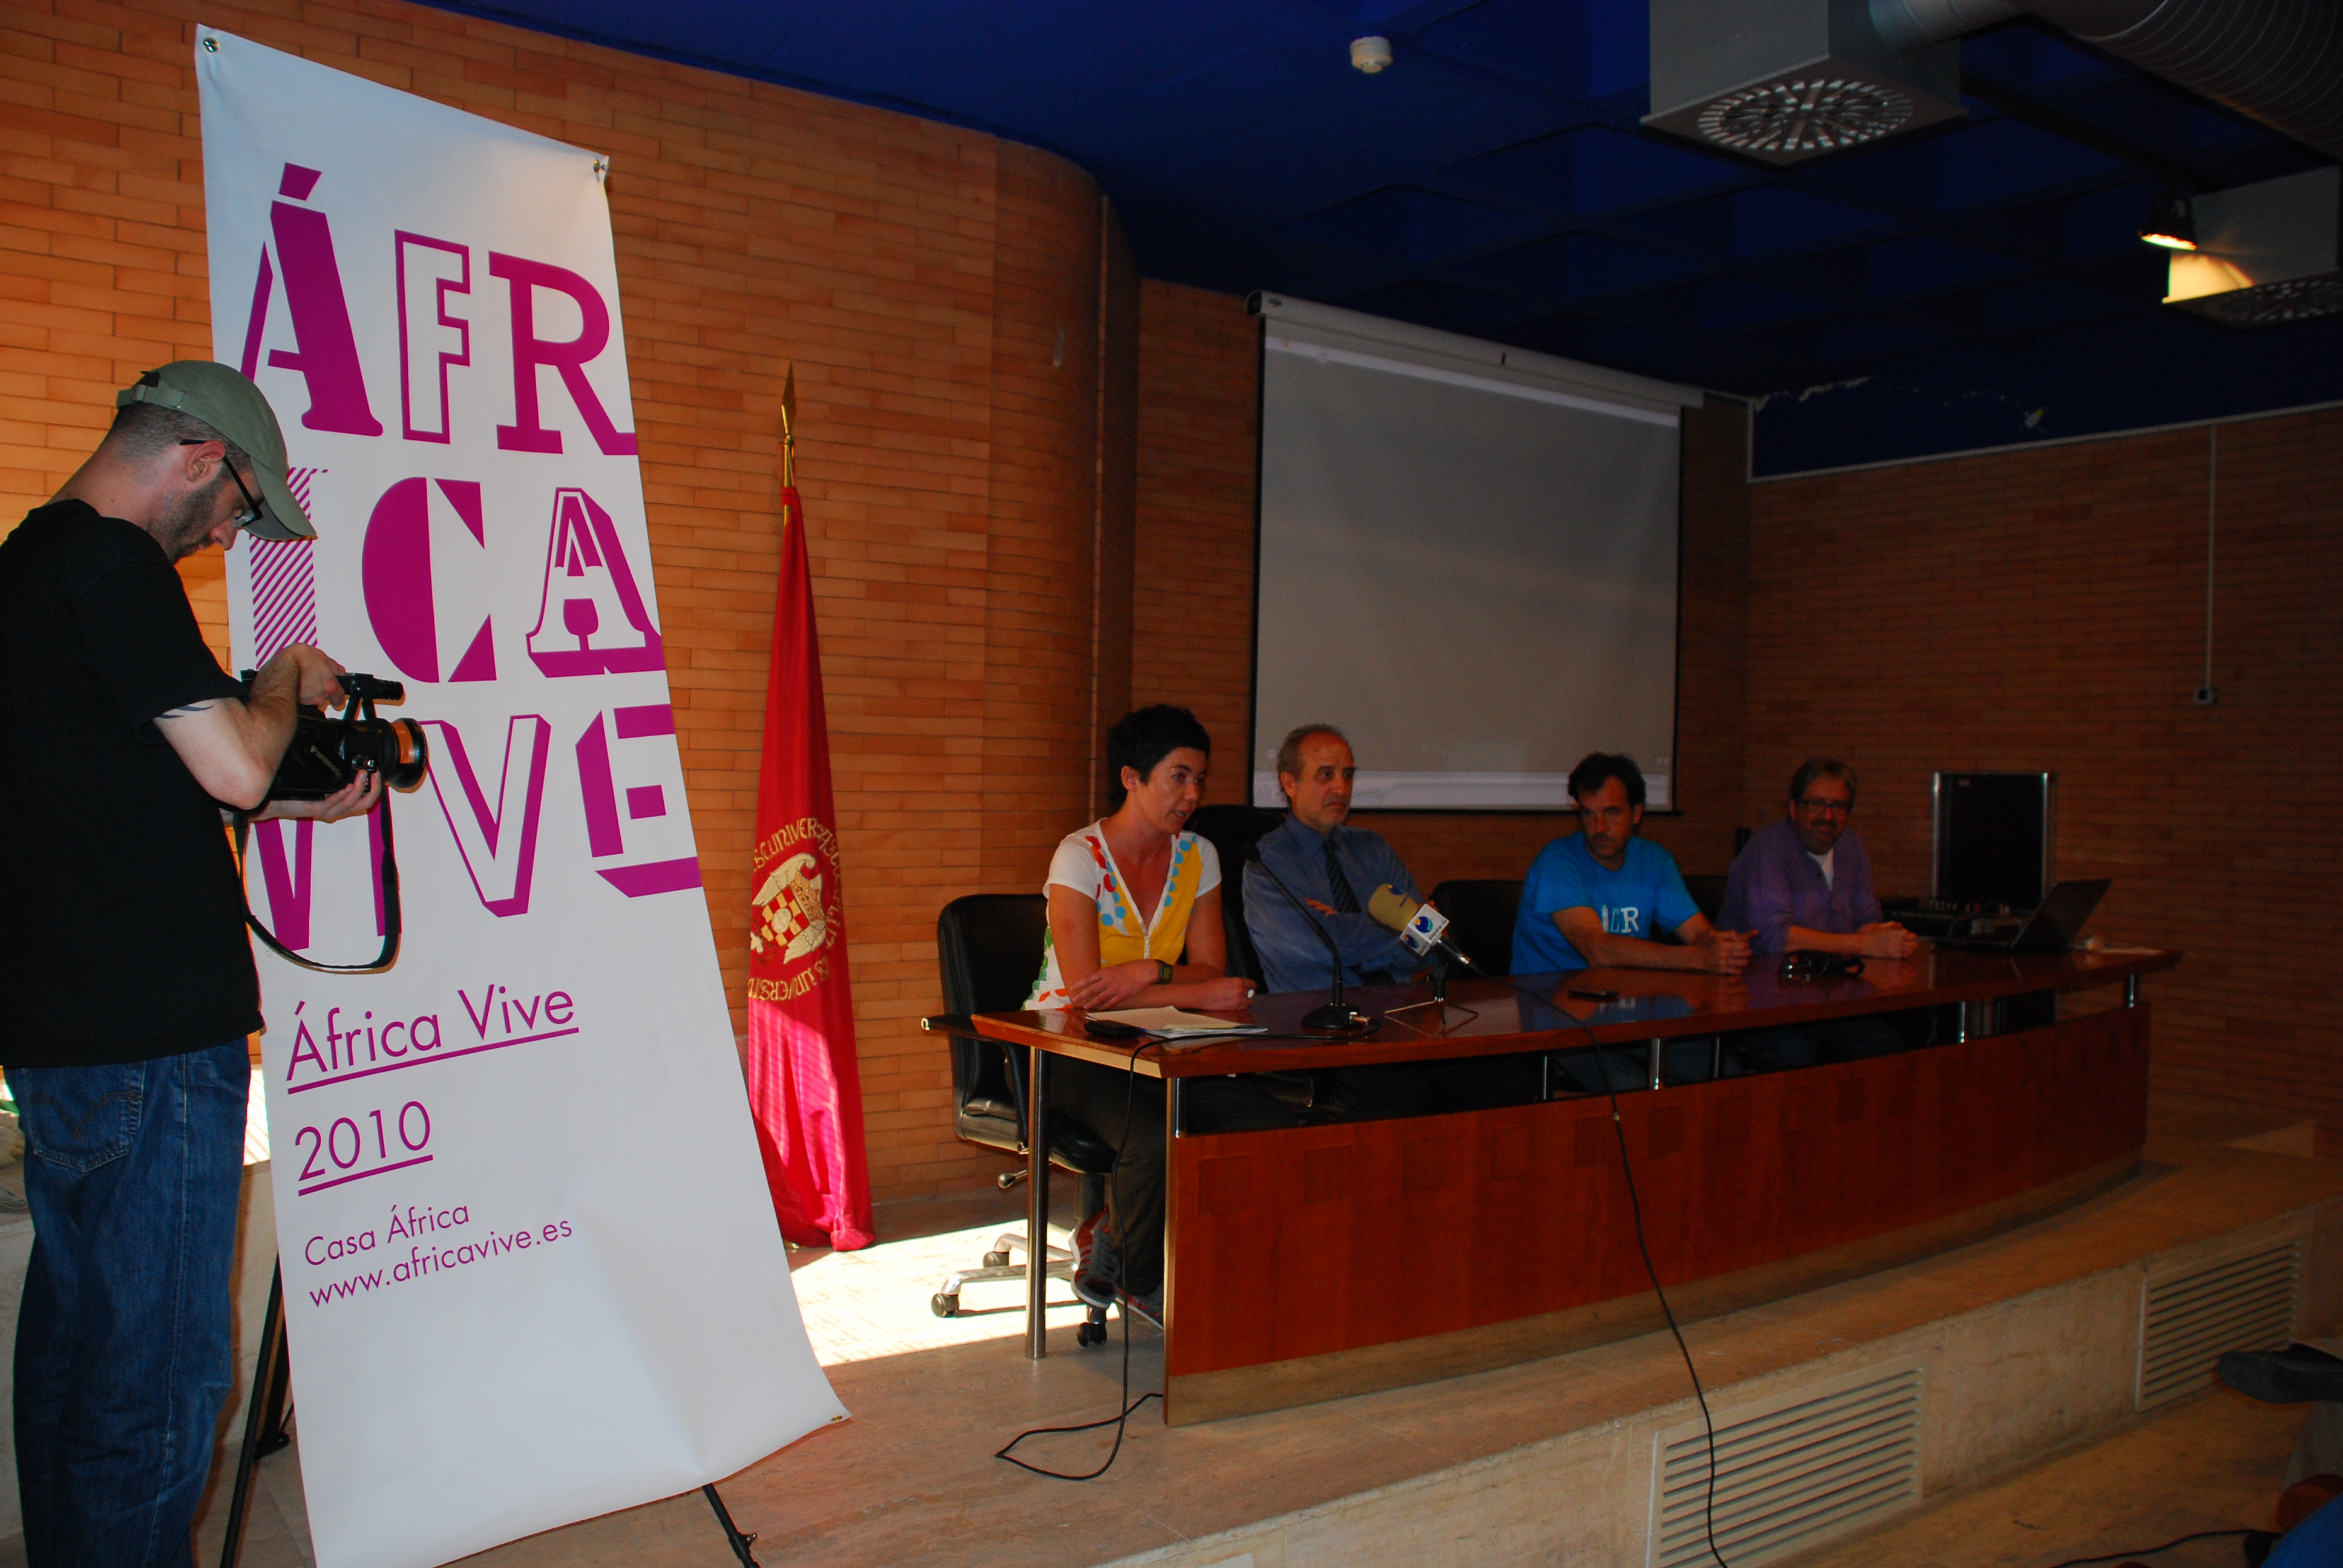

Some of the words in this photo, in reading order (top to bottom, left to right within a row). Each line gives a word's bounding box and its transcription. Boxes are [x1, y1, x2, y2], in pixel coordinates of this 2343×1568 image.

[241, 162, 638, 456] ÁFR
[253, 703, 703, 953] VVE
[286, 1001, 442, 1082] África
[457, 984, 574, 1040] Vive
[295, 1100, 431, 1181] 2010
[305, 1230, 376, 1266] Casa
[387, 1204, 470, 1243] África
[309, 1220, 572, 1307] www.africavive.es
